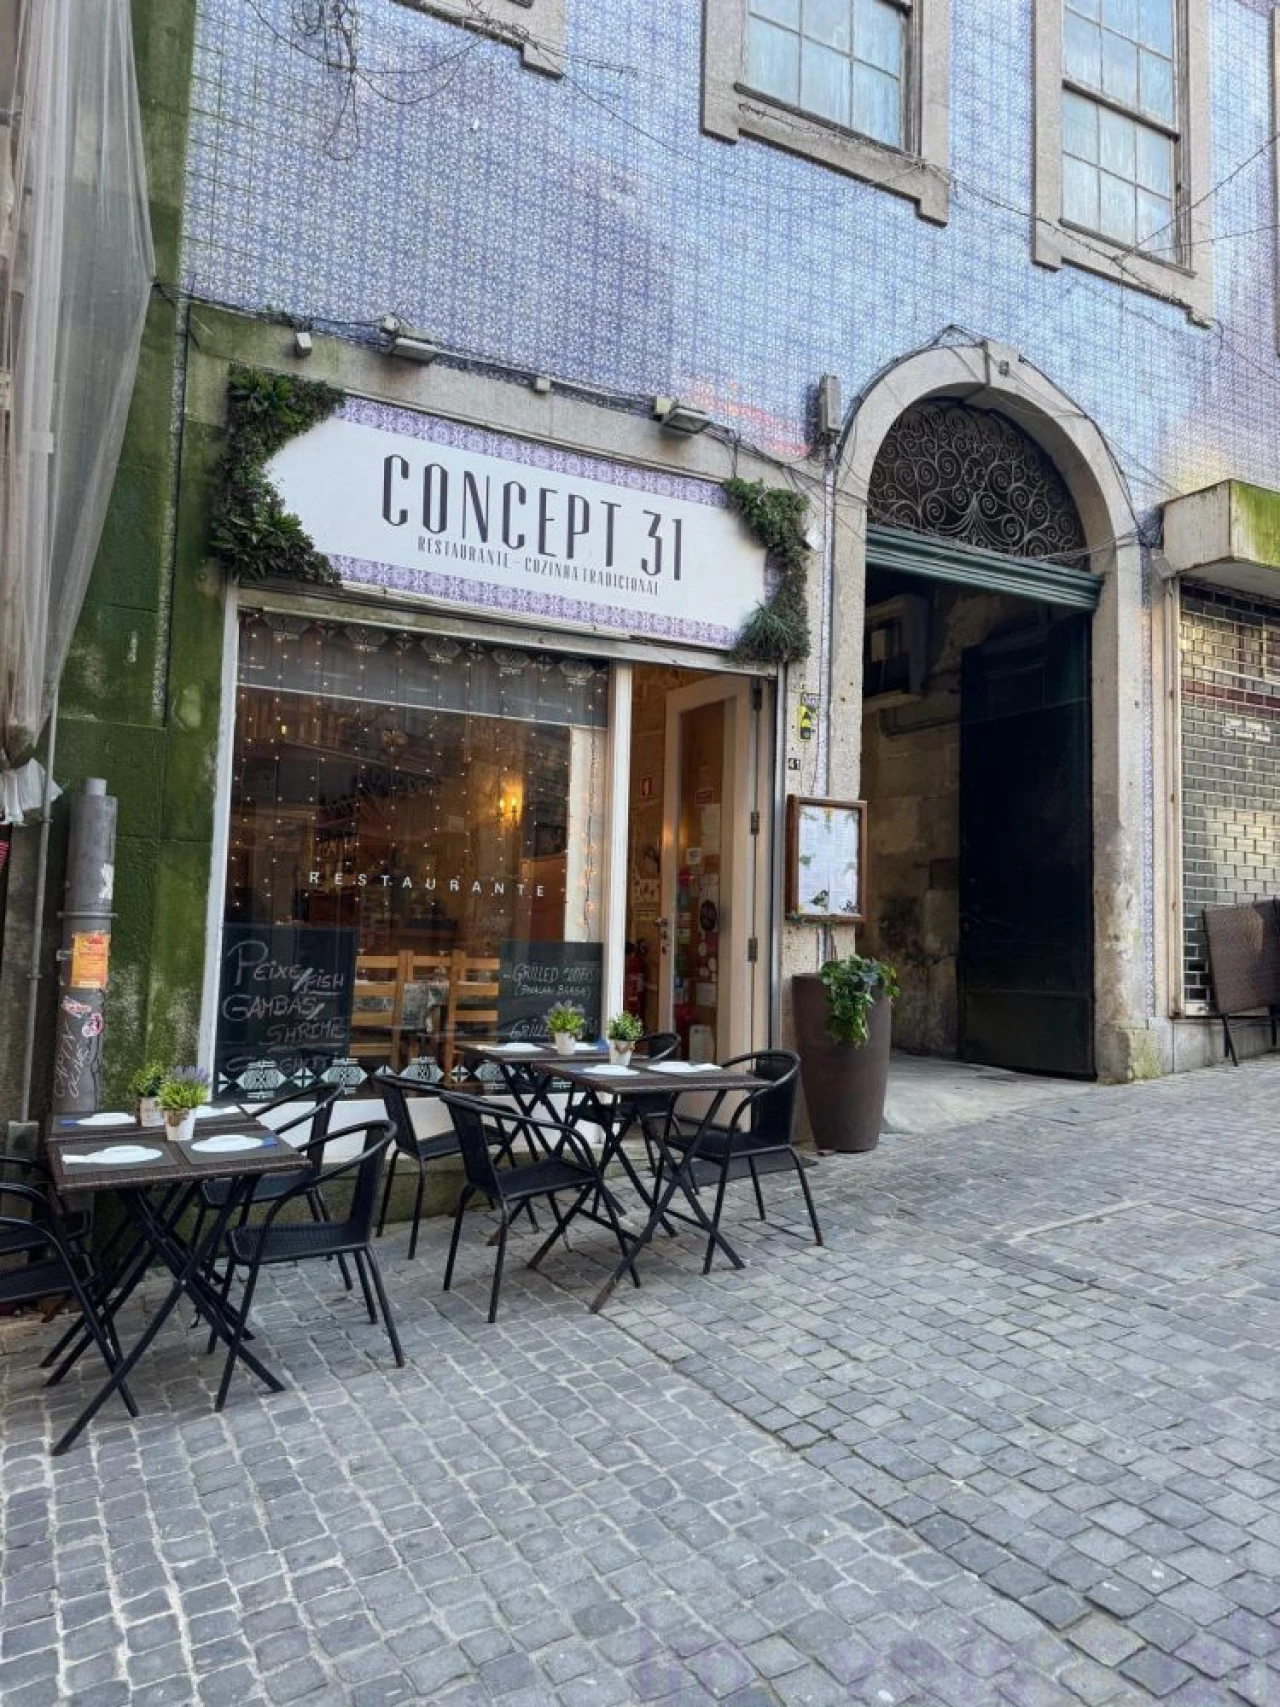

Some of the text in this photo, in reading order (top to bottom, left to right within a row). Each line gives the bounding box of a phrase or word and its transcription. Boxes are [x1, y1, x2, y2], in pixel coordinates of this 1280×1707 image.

[382, 454, 682, 581] CONCEPT 31
[417, 535, 510, 569] RESTAURANTE
[524, 556, 578, 581] COZINHA
[581, 565, 658, 596] TRADICIONAL
[308, 871, 544, 897] RESTAURANTE
